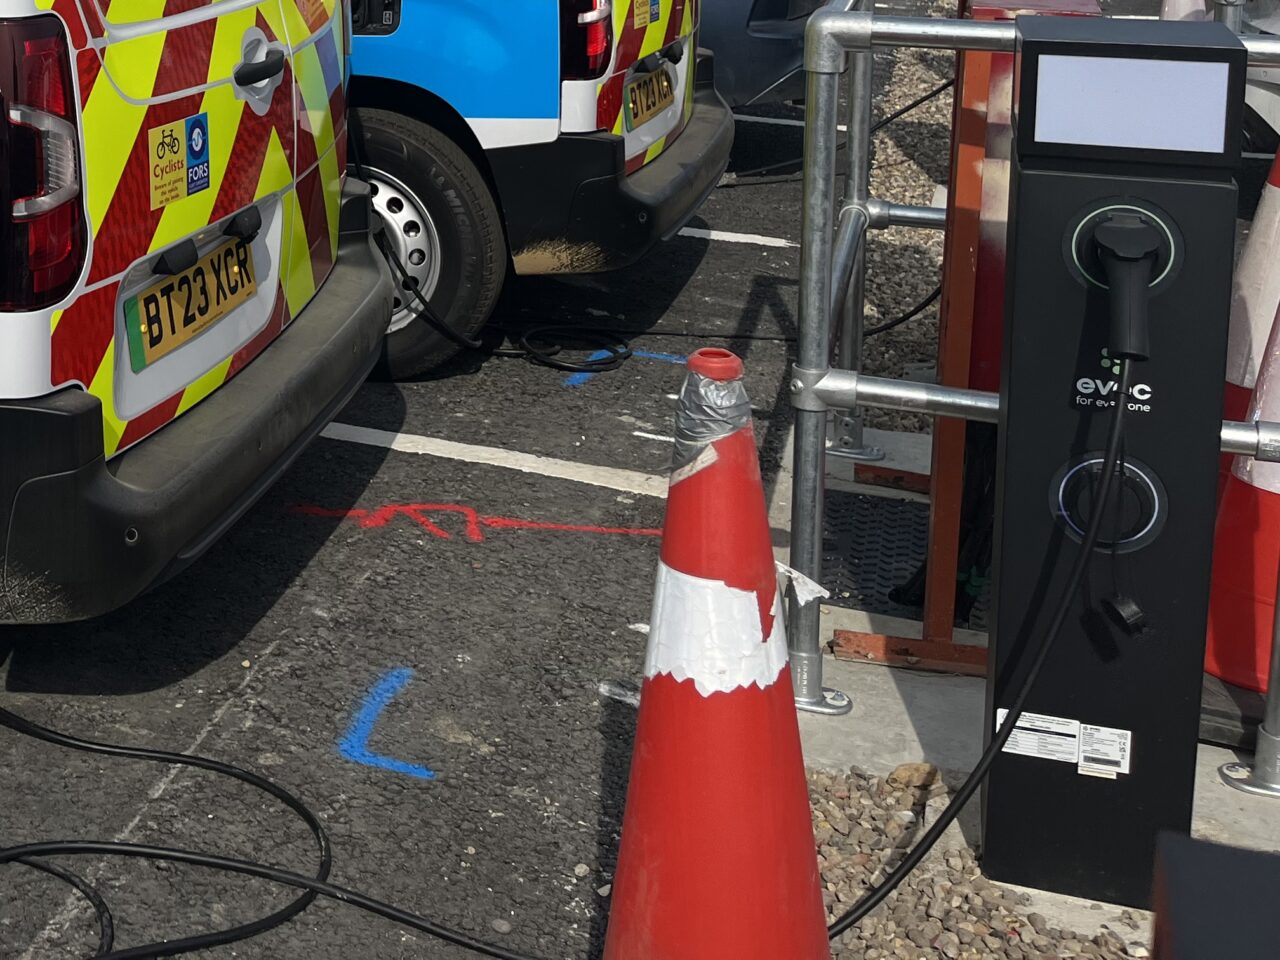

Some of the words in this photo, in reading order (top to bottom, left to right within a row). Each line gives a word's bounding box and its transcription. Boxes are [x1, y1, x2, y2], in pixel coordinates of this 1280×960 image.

[630, 76, 656, 119] BT23
[153, 159, 184, 179] Cyclists
[188, 162, 208, 182] FORS
[143, 266, 209, 348] BT23
[210, 242, 252, 306] XCR
[1076, 395, 1094, 405] for
[1096, 399, 1151, 412] eveone
